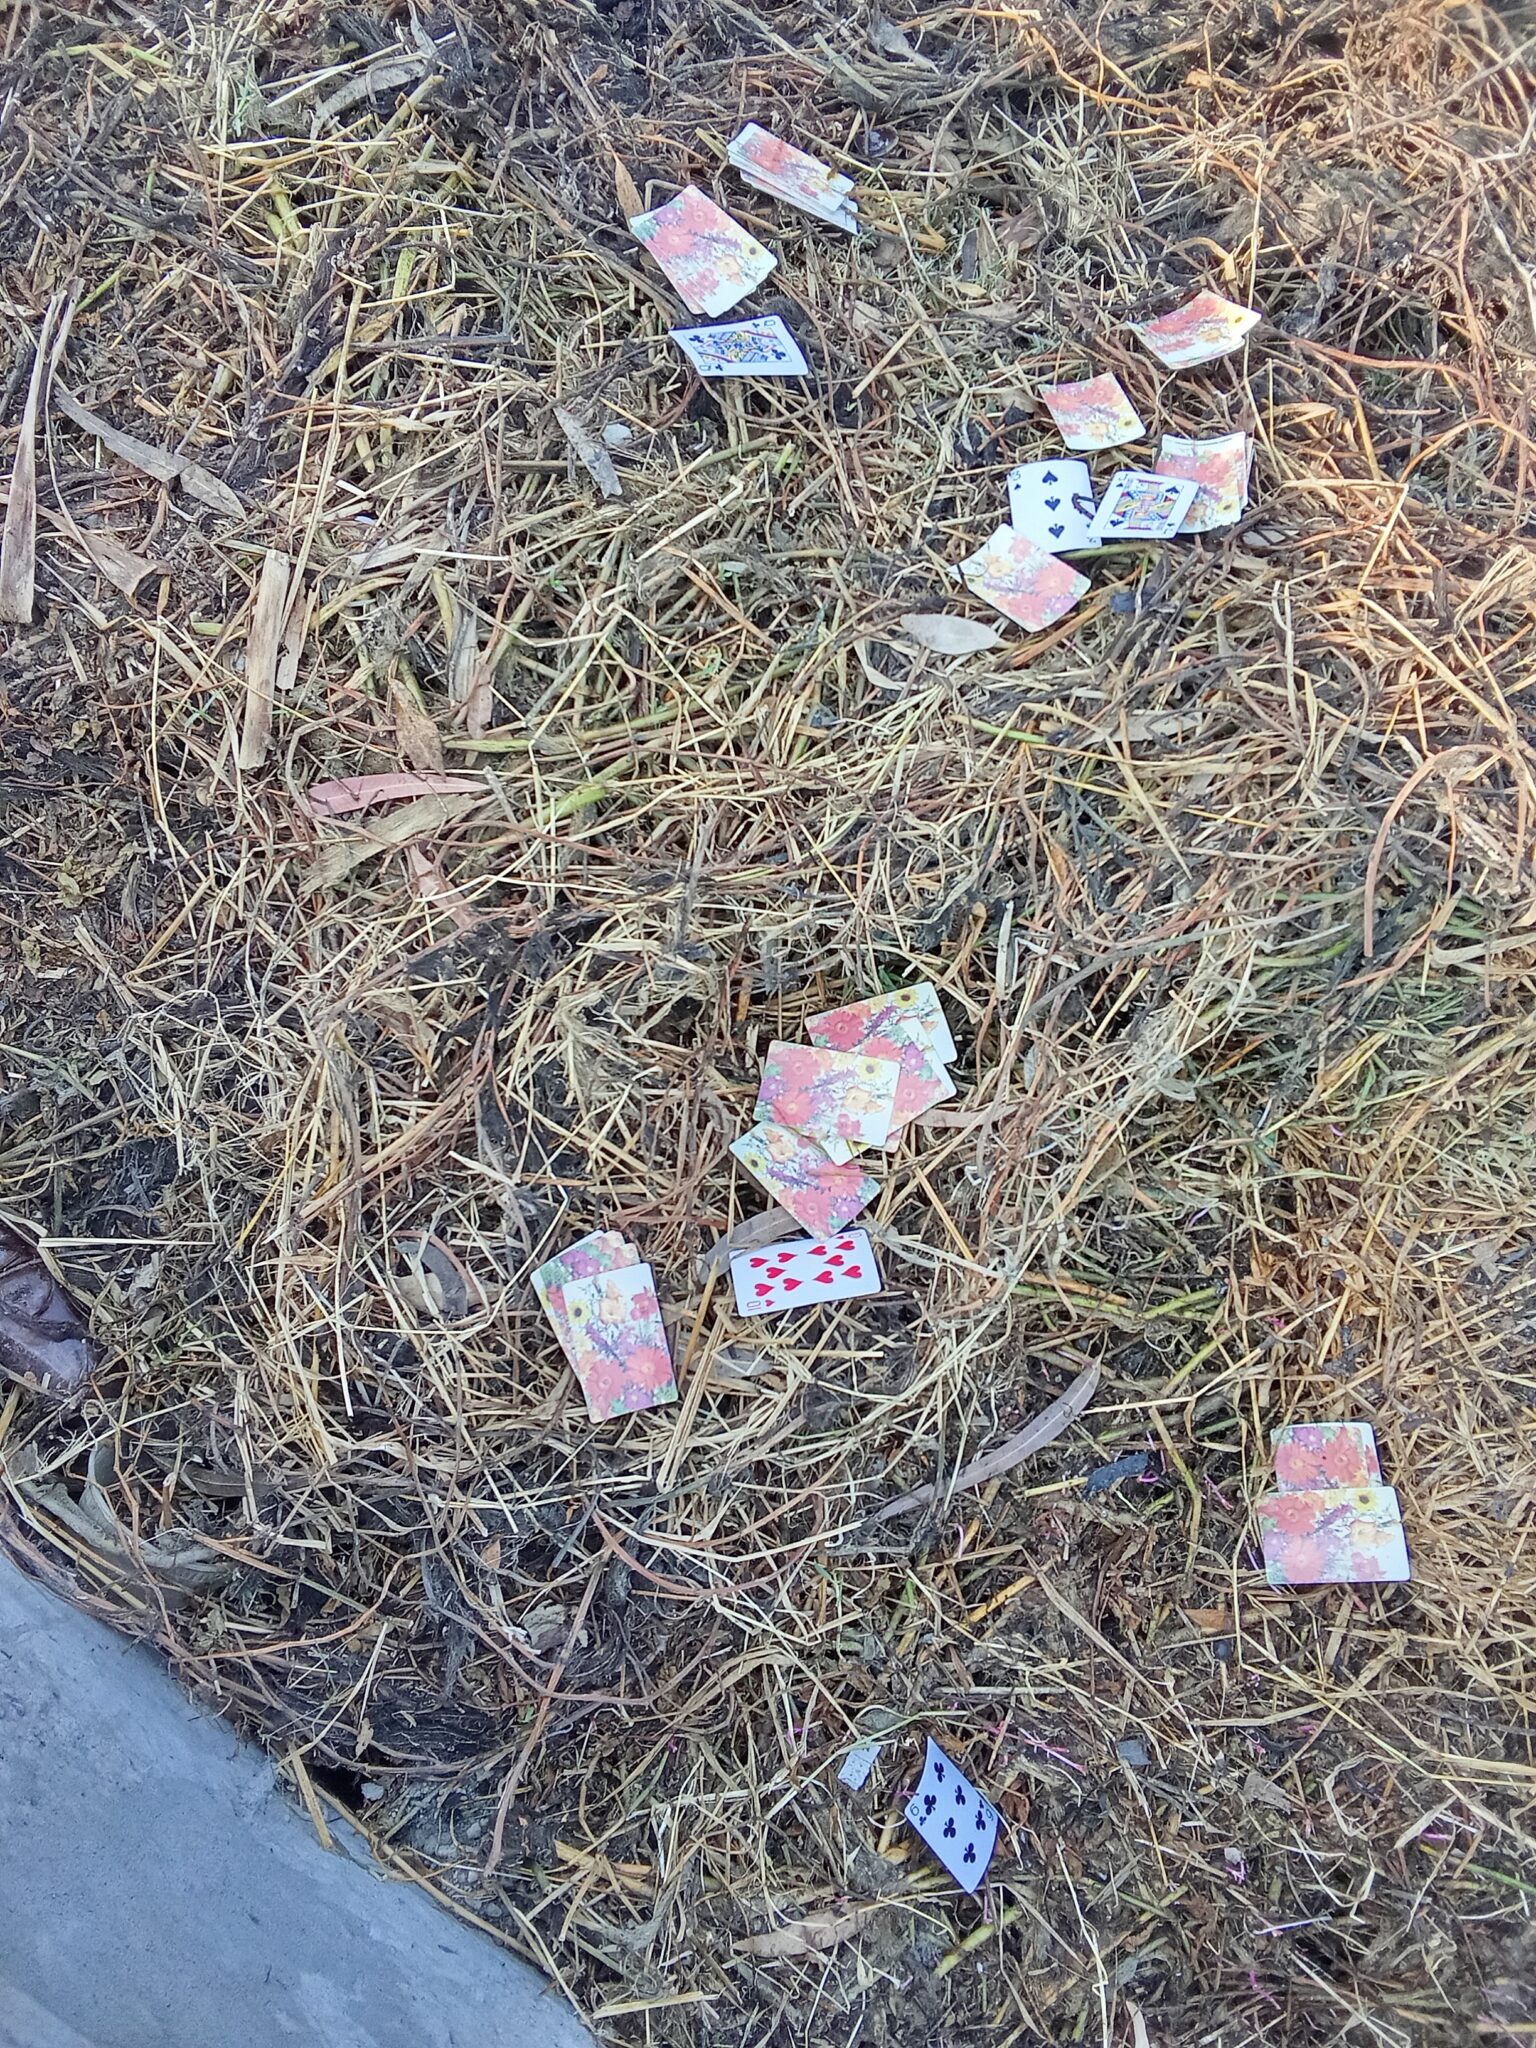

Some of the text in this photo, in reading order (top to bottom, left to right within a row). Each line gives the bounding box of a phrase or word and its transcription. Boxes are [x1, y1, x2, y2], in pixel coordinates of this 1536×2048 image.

[1011, 470, 1021, 481] 3
[746, 1300, 762, 1311] 10
[910, 1803, 920, 1817] 6
[986, 1808, 994, 1821] 6
